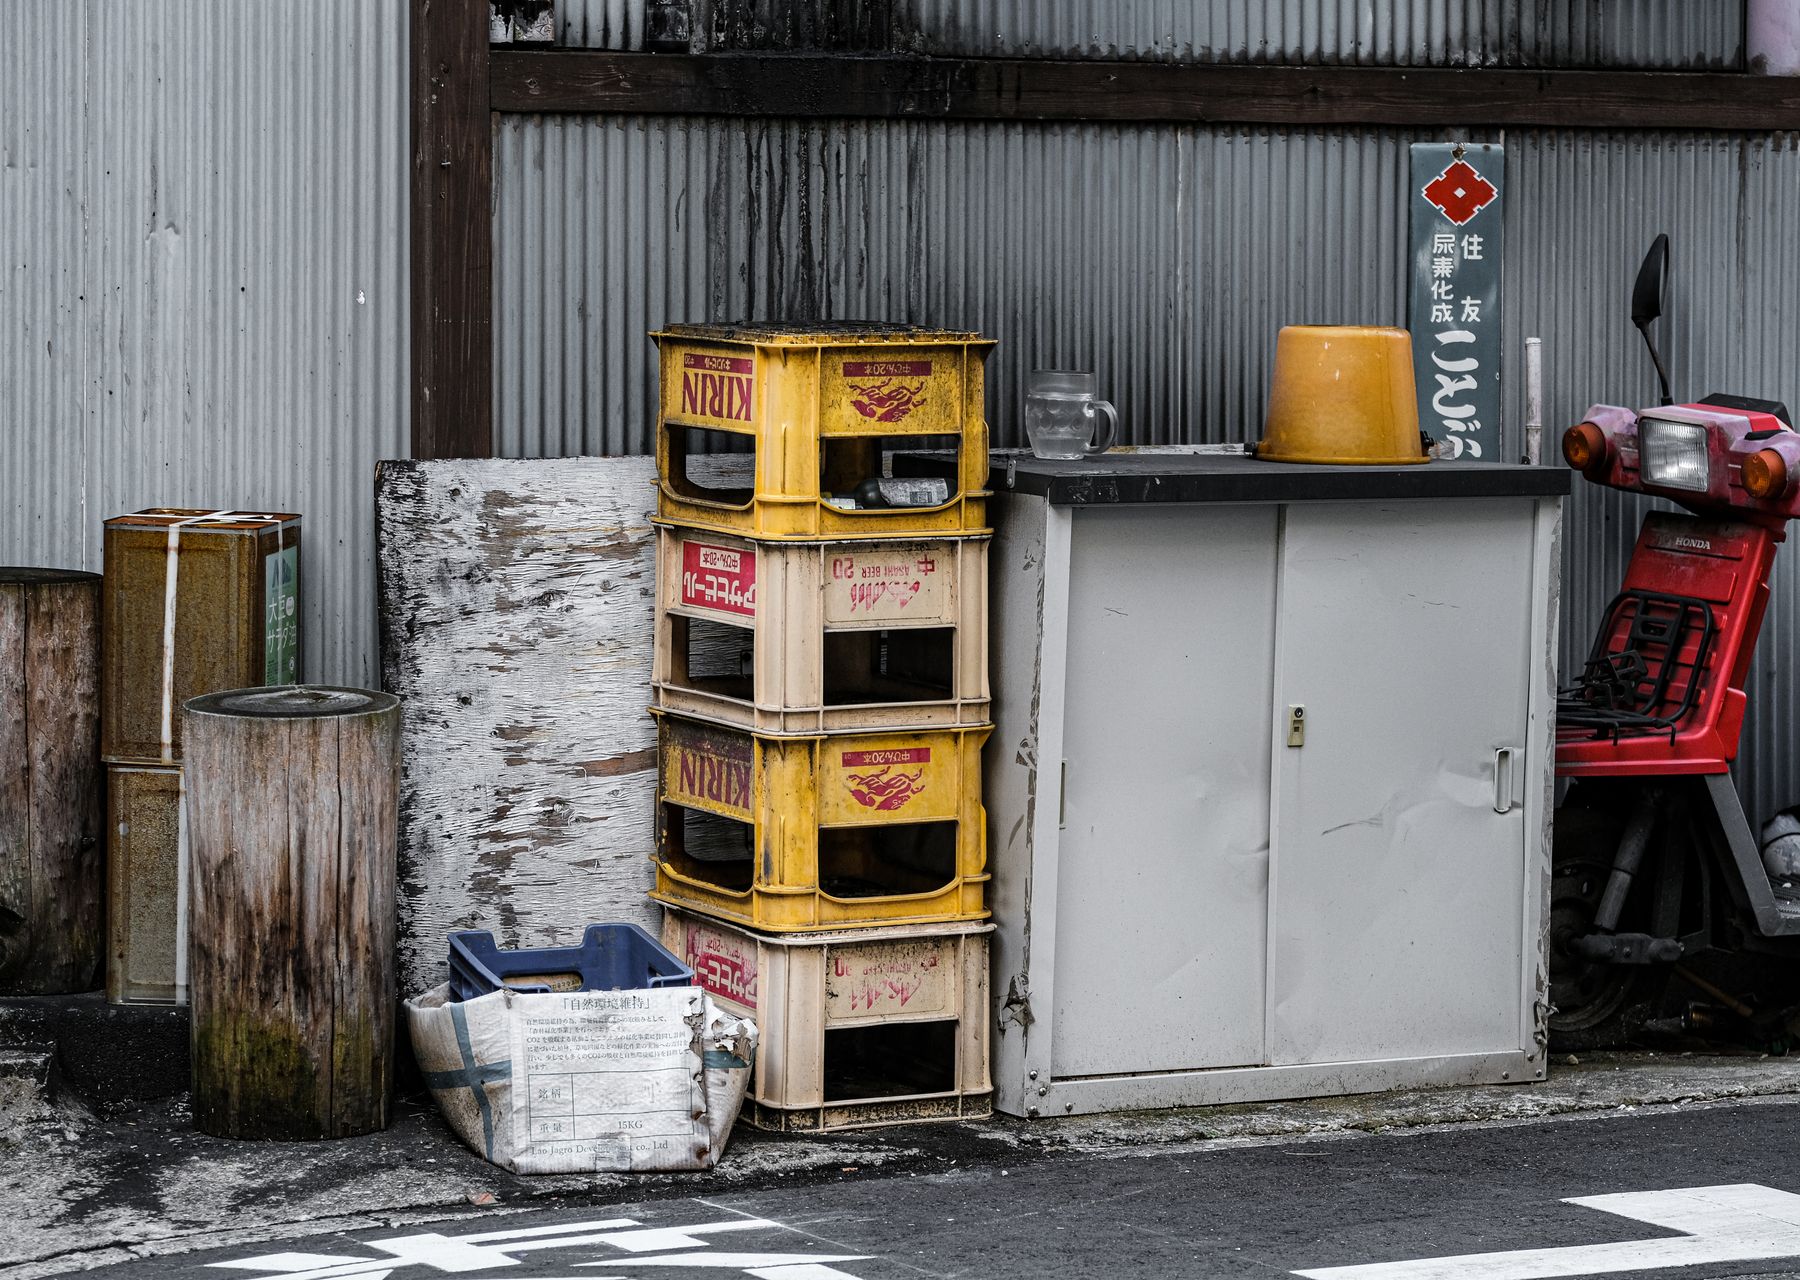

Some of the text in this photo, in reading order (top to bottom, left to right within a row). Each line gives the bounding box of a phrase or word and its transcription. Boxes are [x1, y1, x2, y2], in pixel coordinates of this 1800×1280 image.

[1430, 233, 1456, 324] 尿素化成
[1461, 233, 1484, 323] 住友
[864, 363, 911, 375] 中びん20本
[681, 370, 752, 421] KIRIN
[1675, 536, 1711, 549] HONDA
[832, 557, 854, 580] 20
[861, 564, 910, 579] ASAHI BEER
[683, 571, 757, 609] アサヒビール
[849, 580, 921, 614] Asahi
[863, 751, 911, 763] 中びん20本
[679, 750, 752, 810] KIRIN
[561, 996, 652, 1011] 「自然環境維持」
[617, 1120, 643, 1130] 15KG
[653, 1139, 669, 1150] Ltd
